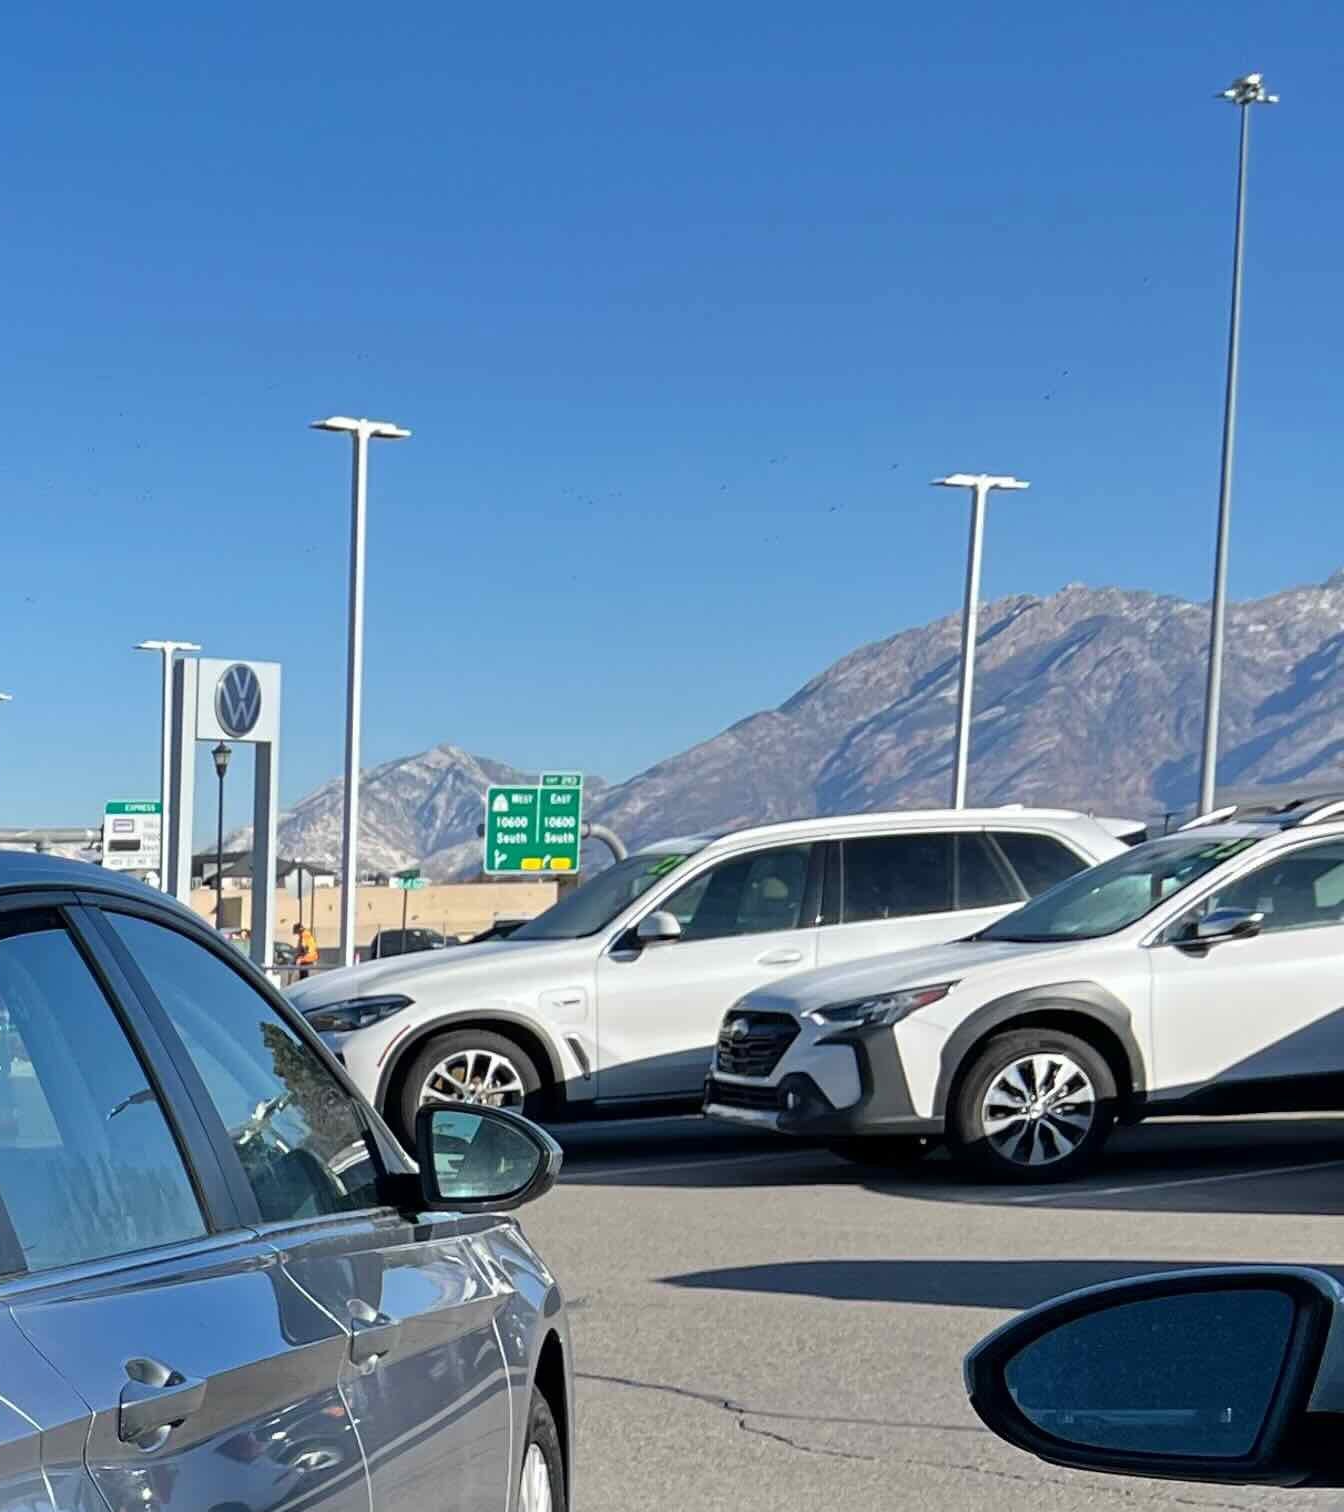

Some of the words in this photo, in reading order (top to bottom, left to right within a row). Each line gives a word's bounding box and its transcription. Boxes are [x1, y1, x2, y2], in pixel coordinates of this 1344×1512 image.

[550, 793, 572, 805] EAST
[124, 803, 157, 812] EXPRESS
[496, 816, 528, 828] 10600
[544, 816, 576, 828] 10600
[496, 832, 528, 844] South
[543, 832, 575, 844] South
